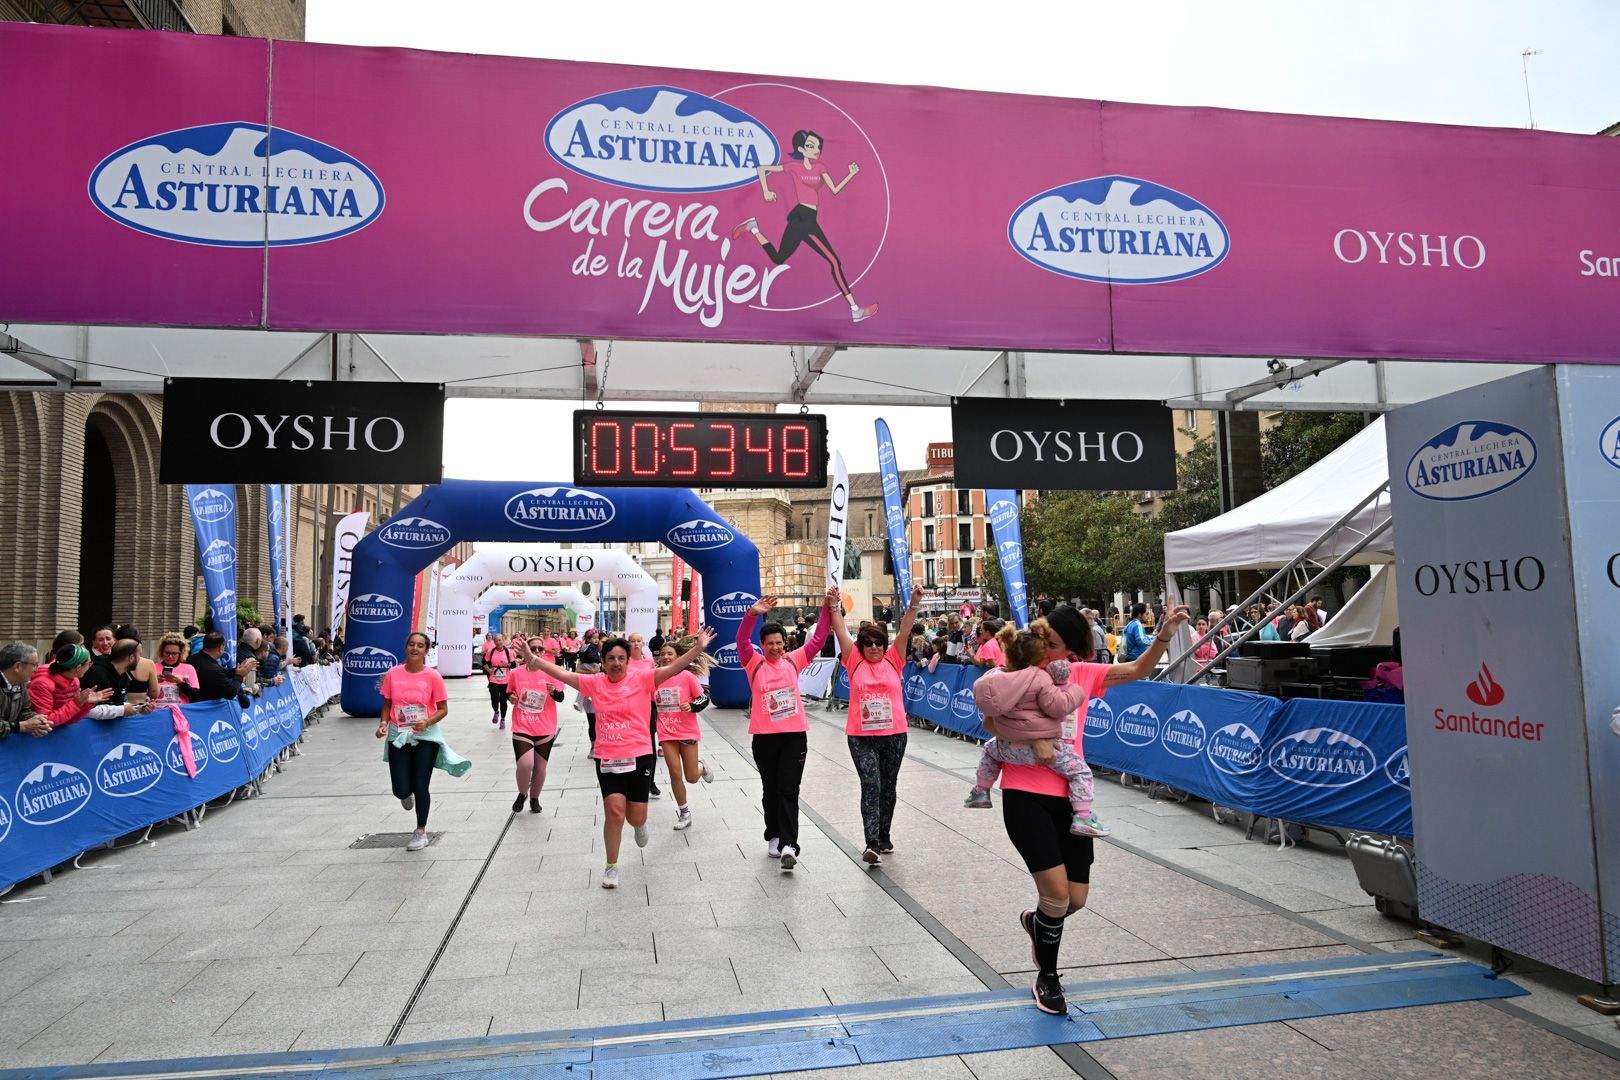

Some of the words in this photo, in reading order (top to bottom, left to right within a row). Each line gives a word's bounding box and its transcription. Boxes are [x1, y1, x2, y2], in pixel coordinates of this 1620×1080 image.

[600, 118, 675, 134] CENTRAL
[682, 124, 755, 139] LECHERA
[563, 119, 761, 169] ASTURIANA
[161, 162, 253, 177] CENTRAL
[262, 166, 354, 181] LECHERA
[112, 163, 363, 218] ASTURIANA
[523, 177, 719, 242] Carrera
[1060, 211, 1130, 224] CENTRAL
[1137, 214, 1206, 227] LECHERA
[1027, 212, 1214, 257] ASTURIANA
[1333, 228, 1487, 269] OYSHO
[571, 238, 609, 277] de
[617, 239, 644, 279] la
[637, 238, 791, 328] Mujer
[209, 413, 405, 453] OYSHO
[990, 429, 1144, 463] OYSHO
[931, 448, 953, 459] TIBU
[1430, 449, 1472, 463] CENTRAL
[1474, 438, 1520, 453] LECHERA
[1415, 448, 1527, 488] ASTURIANA
[513, 500, 607, 520] ASTURIANA
[383, 528, 445, 541] ASTURIANA
[673, 531, 730, 543] ASTURIANA
[508, 555, 595, 573] OYSHO
[1414, 556, 1545, 596] OYSHO
[350, 604, 399, 616] ASTURIANA
[714, 602, 753, 614] ASTURI
[1085, 715, 1109, 730] TURIANA
[1117, 716, 1155, 738] ASTURIANA
[1434, 708, 1544, 741] Santander
[103, 761, 160, 789] ASTURIANA
[1273, 746, 1366, 776] ASTURIANA
[23, 782, 88, 816] ASTURIANA
